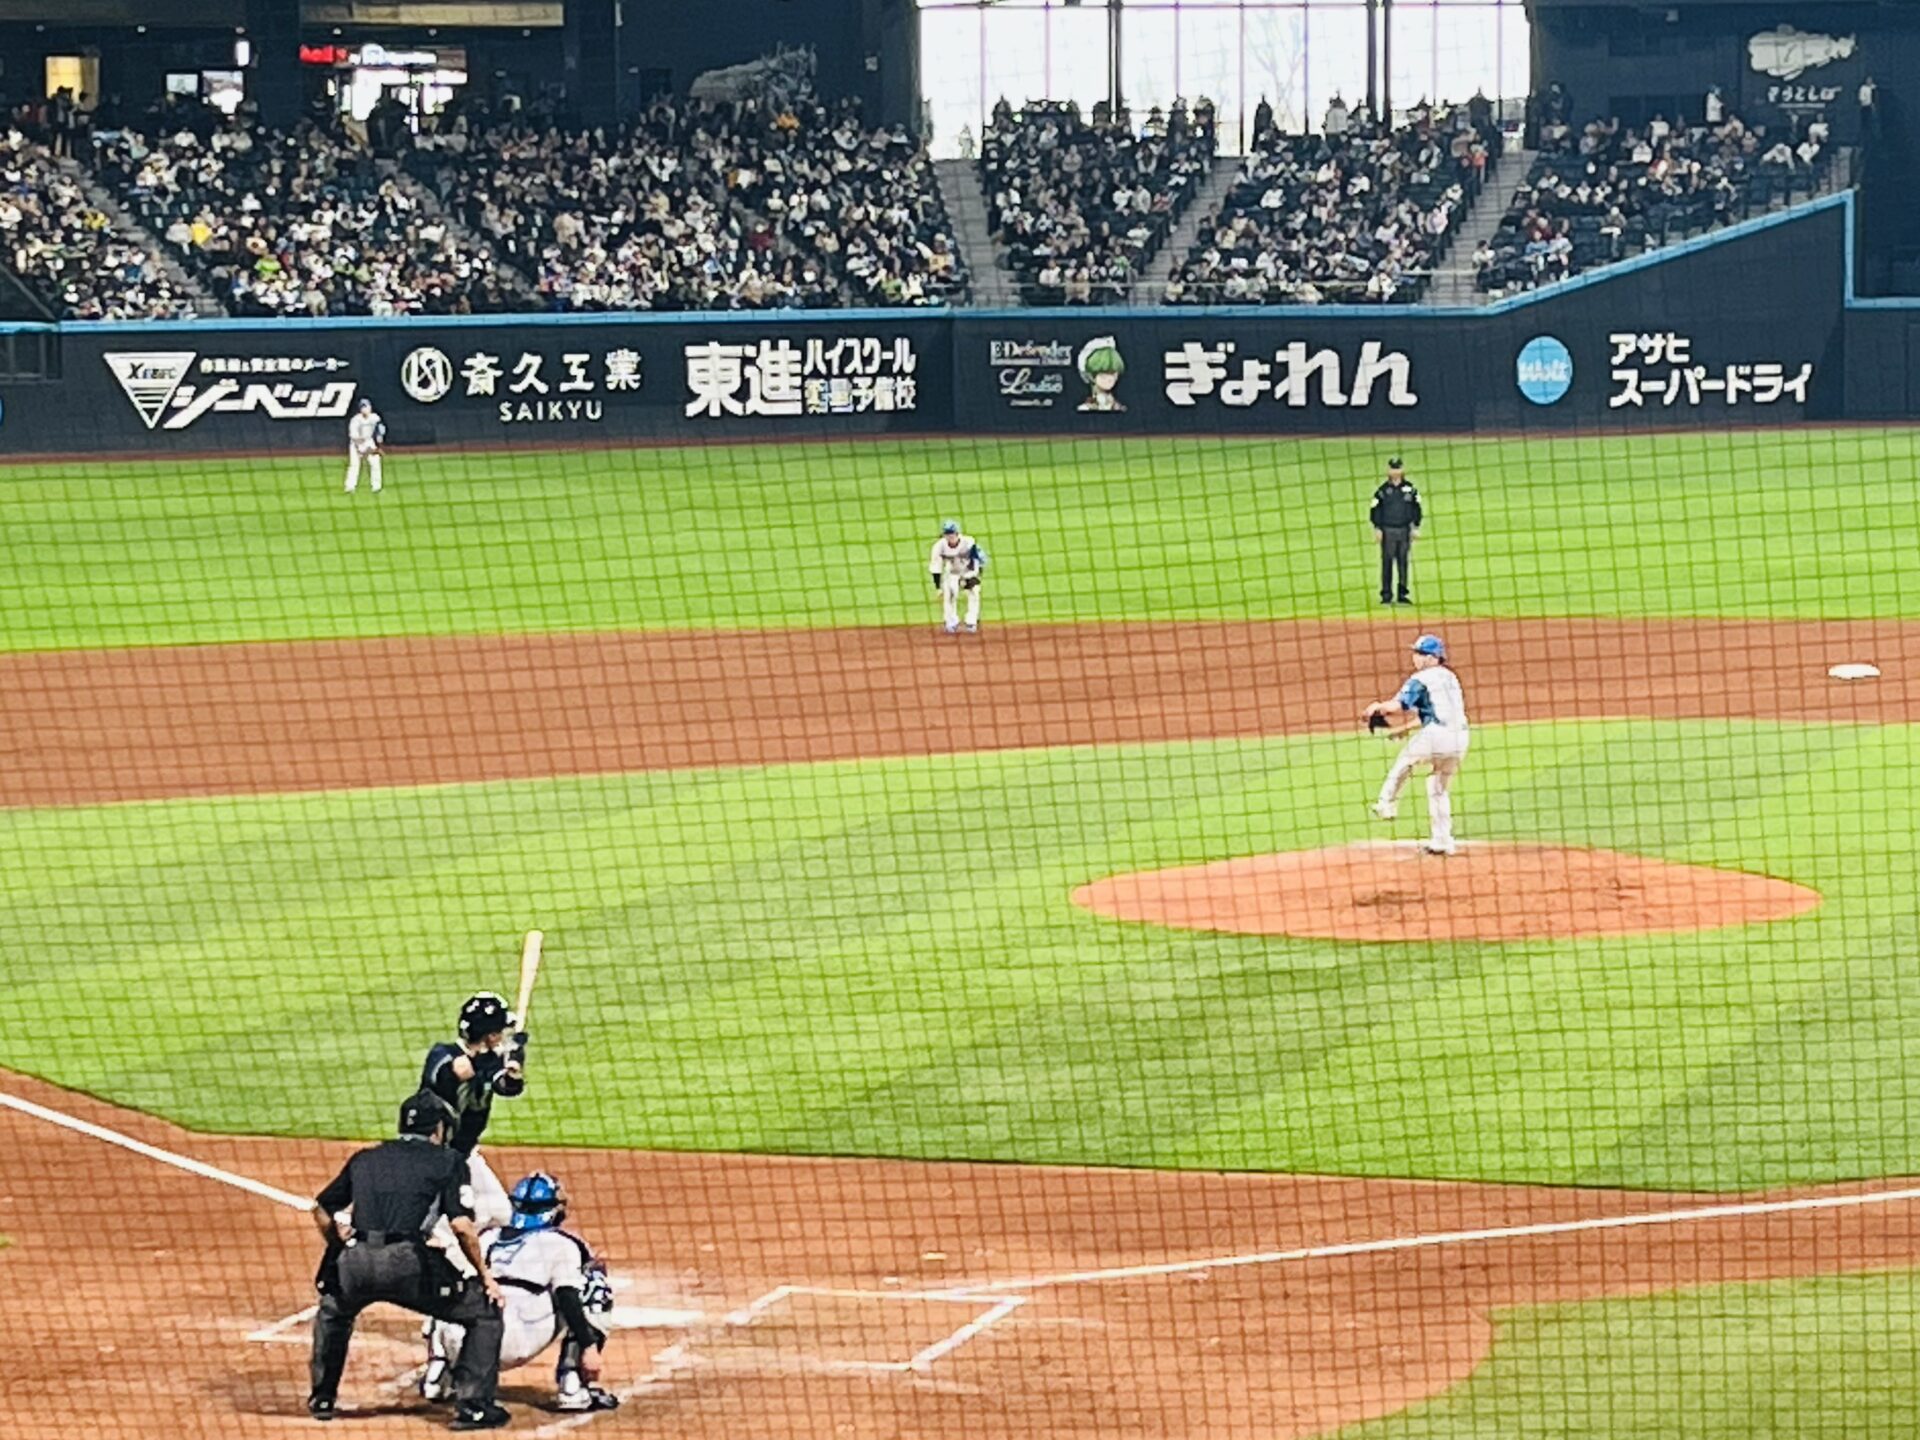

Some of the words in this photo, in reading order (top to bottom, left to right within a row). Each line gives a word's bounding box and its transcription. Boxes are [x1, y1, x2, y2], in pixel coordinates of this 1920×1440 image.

[803, 337, 916, 375] ハイスクール
[1609, 332, 1690, 365] アサヒ
[684, 340, 803, 417] 東進
[1164, 341, 1418, 406] ぎょれん
[1609, 362, 1812, 408] スーパードライ
[499, 400, 602, 422] SAIKYU
